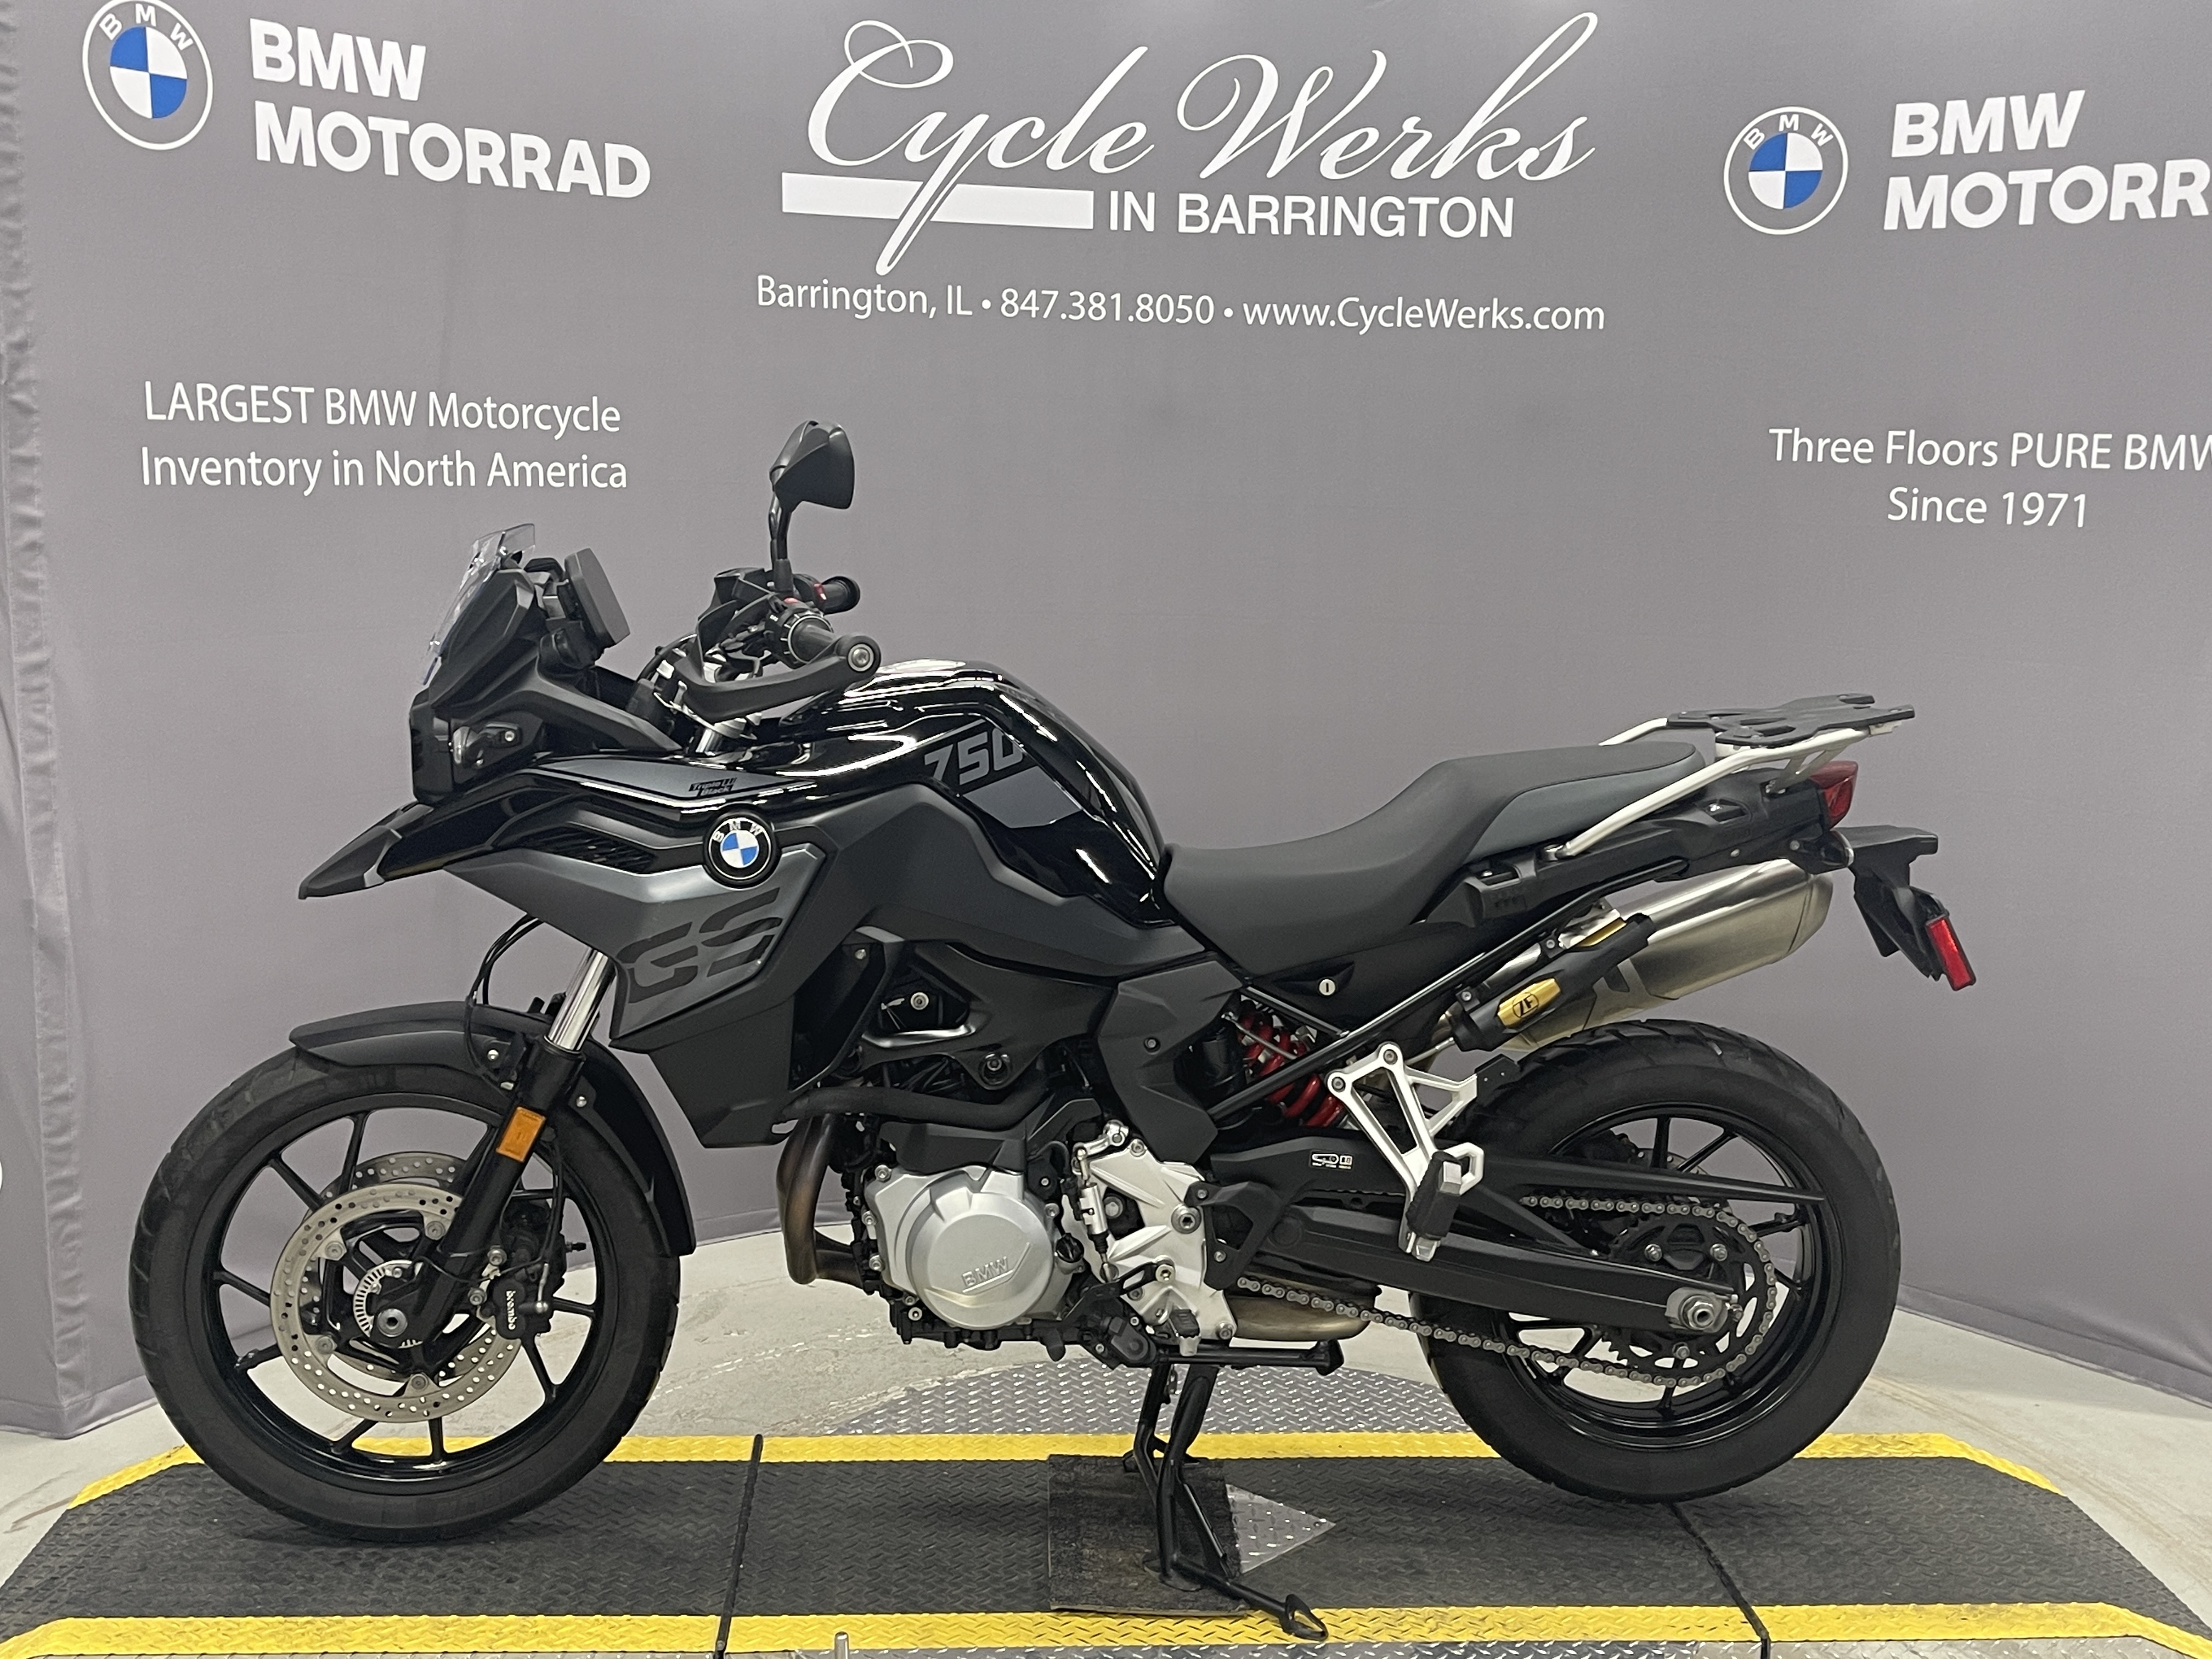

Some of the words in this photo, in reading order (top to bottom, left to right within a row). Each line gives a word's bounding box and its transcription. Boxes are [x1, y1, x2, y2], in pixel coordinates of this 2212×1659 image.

[99, 3, 194, 50] BMW
[250, 18, 426, 101] BMW
[255, 100, 651, 198] MOTORRAD
[809, 20, 1155, 276] Cycle
[1177, 12, 1599, 181] Werks
[1743, 114, 1833, 148] BMW
[1891, 89, 2086, 157] BMW
[1110, 190, 1155, 232] IN
[1178, 193, 1514, 238] BARRINGTON
[1883, 159, 2211, 230] MOTORR
[758, 275, 936, 320] Barrington,
[947, 285, 974, 315] IL
[1001, 288, 1214, 325] 847.381.8050
[1243, 296, 1604, 335] www.CycleWerks.com
[145, 381, 314, 424] LARGEST
[325, 388, 417, 426] BMW
[429, 391, 620, 441] Motorcycle
[140, 447, 322, 496] Inventory
[332, 449, 364, 486] in
[376, 450, 476, 487] North
[487, 452, 627, 488] America
[1769, 427, 1874, 464] Three
[1886, 429, 1998, 467] Floors
[2011, 432, 2113, 469] PURE
[1888, 487, 1987, 524] Since
[2002, 492, 2086, 528] 1971
[924, 727, 1023, 786] 750
[712, 820, 764, 843] BMW
[961, 1256, 1008, 1287] BMW
